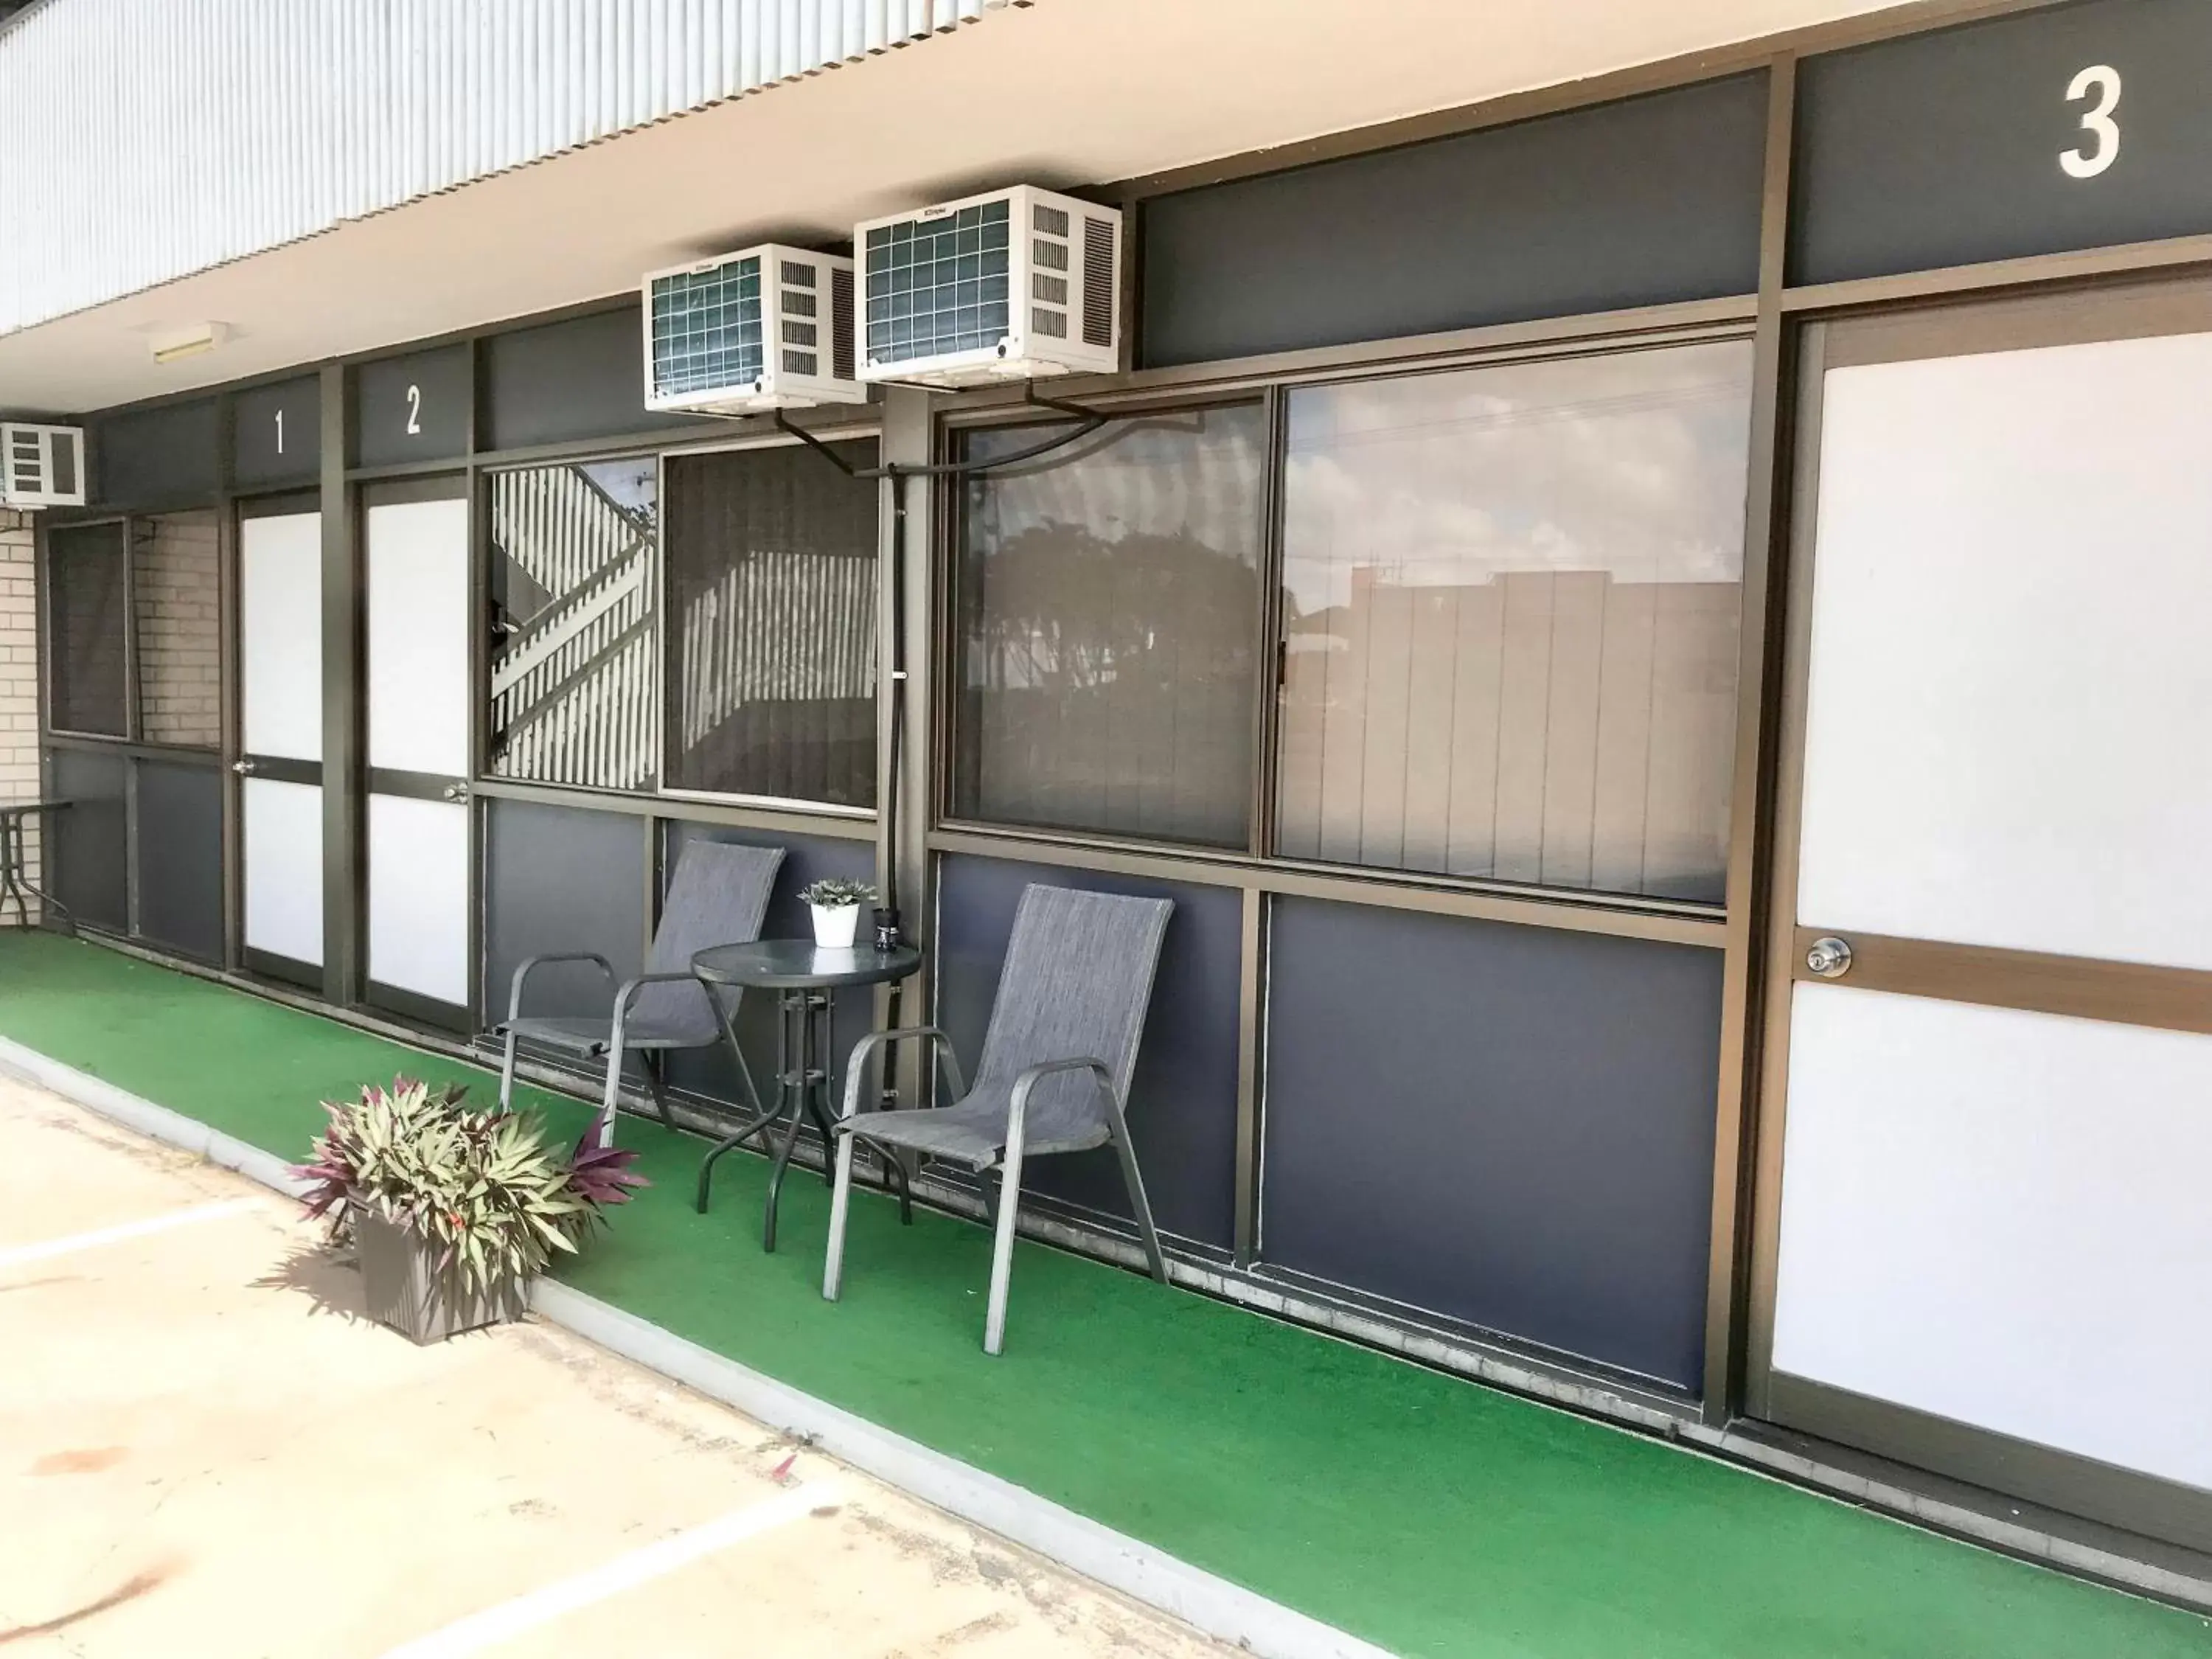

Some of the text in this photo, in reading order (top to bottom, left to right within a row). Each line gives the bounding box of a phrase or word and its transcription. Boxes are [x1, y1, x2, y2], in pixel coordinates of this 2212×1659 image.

[2059, 65, 2121, 178] 3
[275, 410, 282, 453] 1
[407, 385, 421, 434] 2
